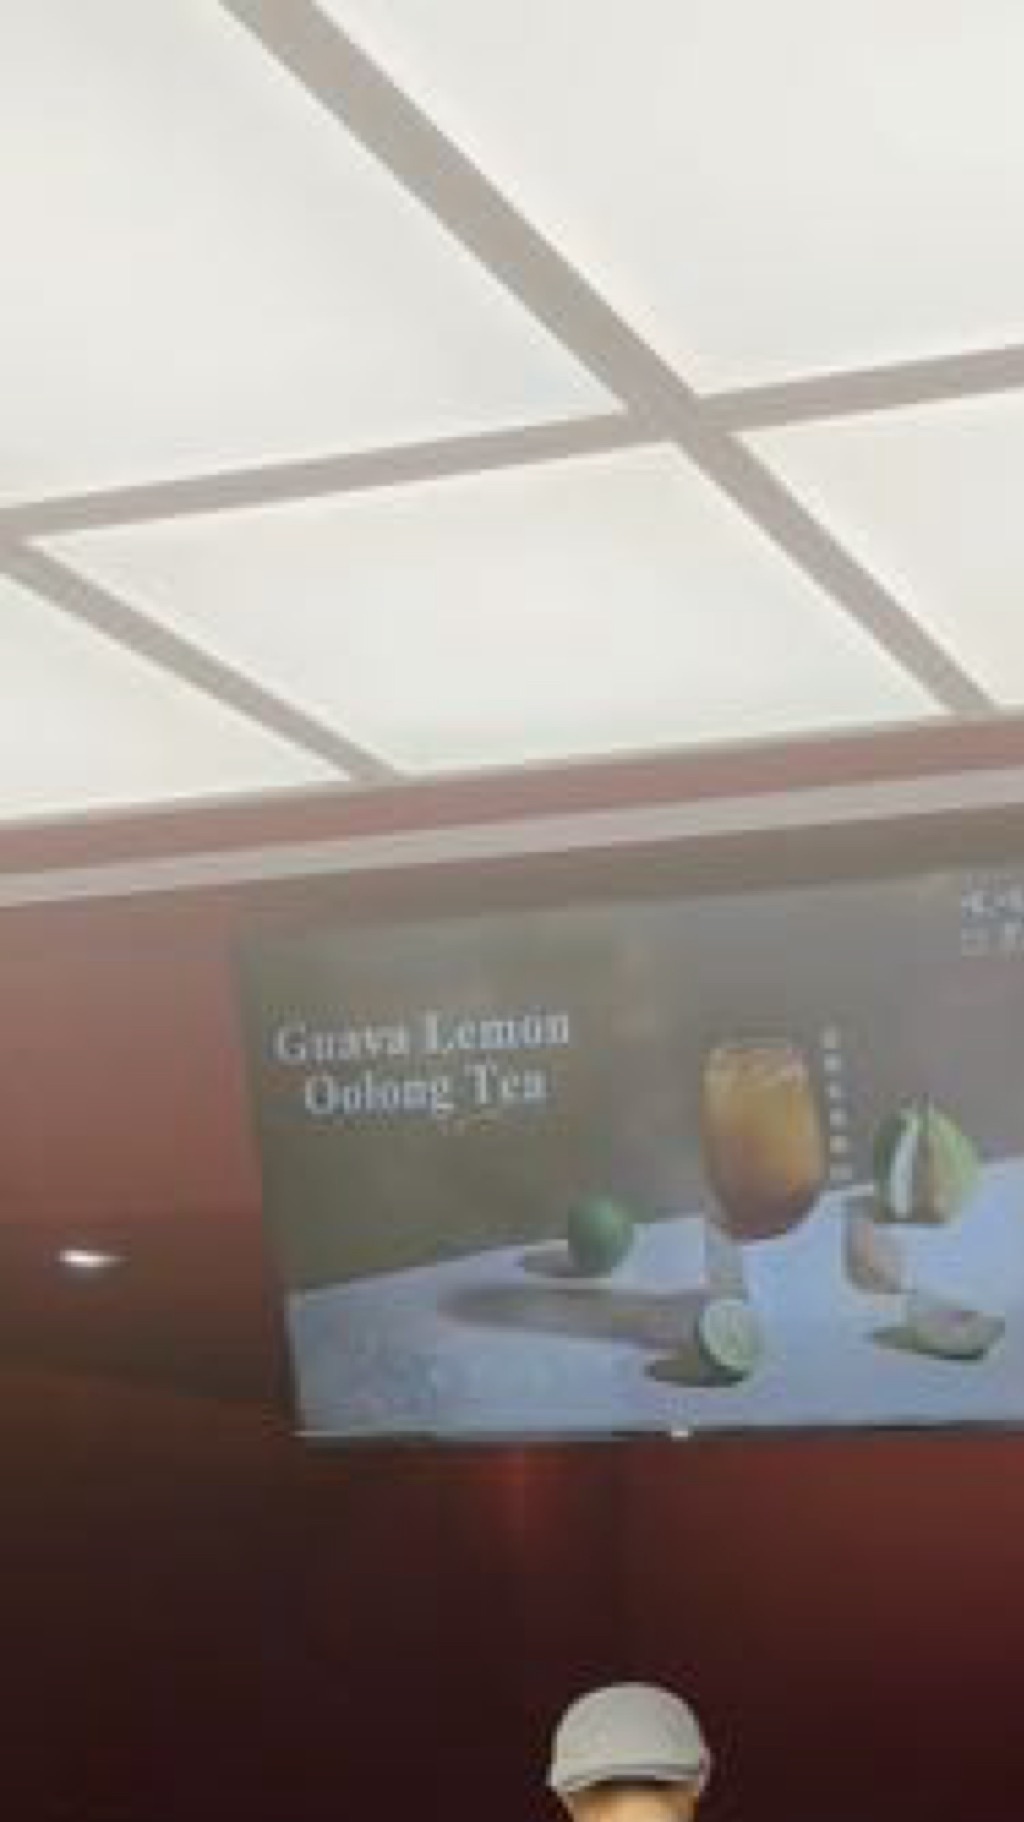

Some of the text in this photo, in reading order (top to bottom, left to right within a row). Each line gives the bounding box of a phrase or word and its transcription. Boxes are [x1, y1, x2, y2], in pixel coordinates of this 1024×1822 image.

[275, 1011, 569, 1063] Guava Lemon
[304, 1063, 547, 1121] Oolong Tea
